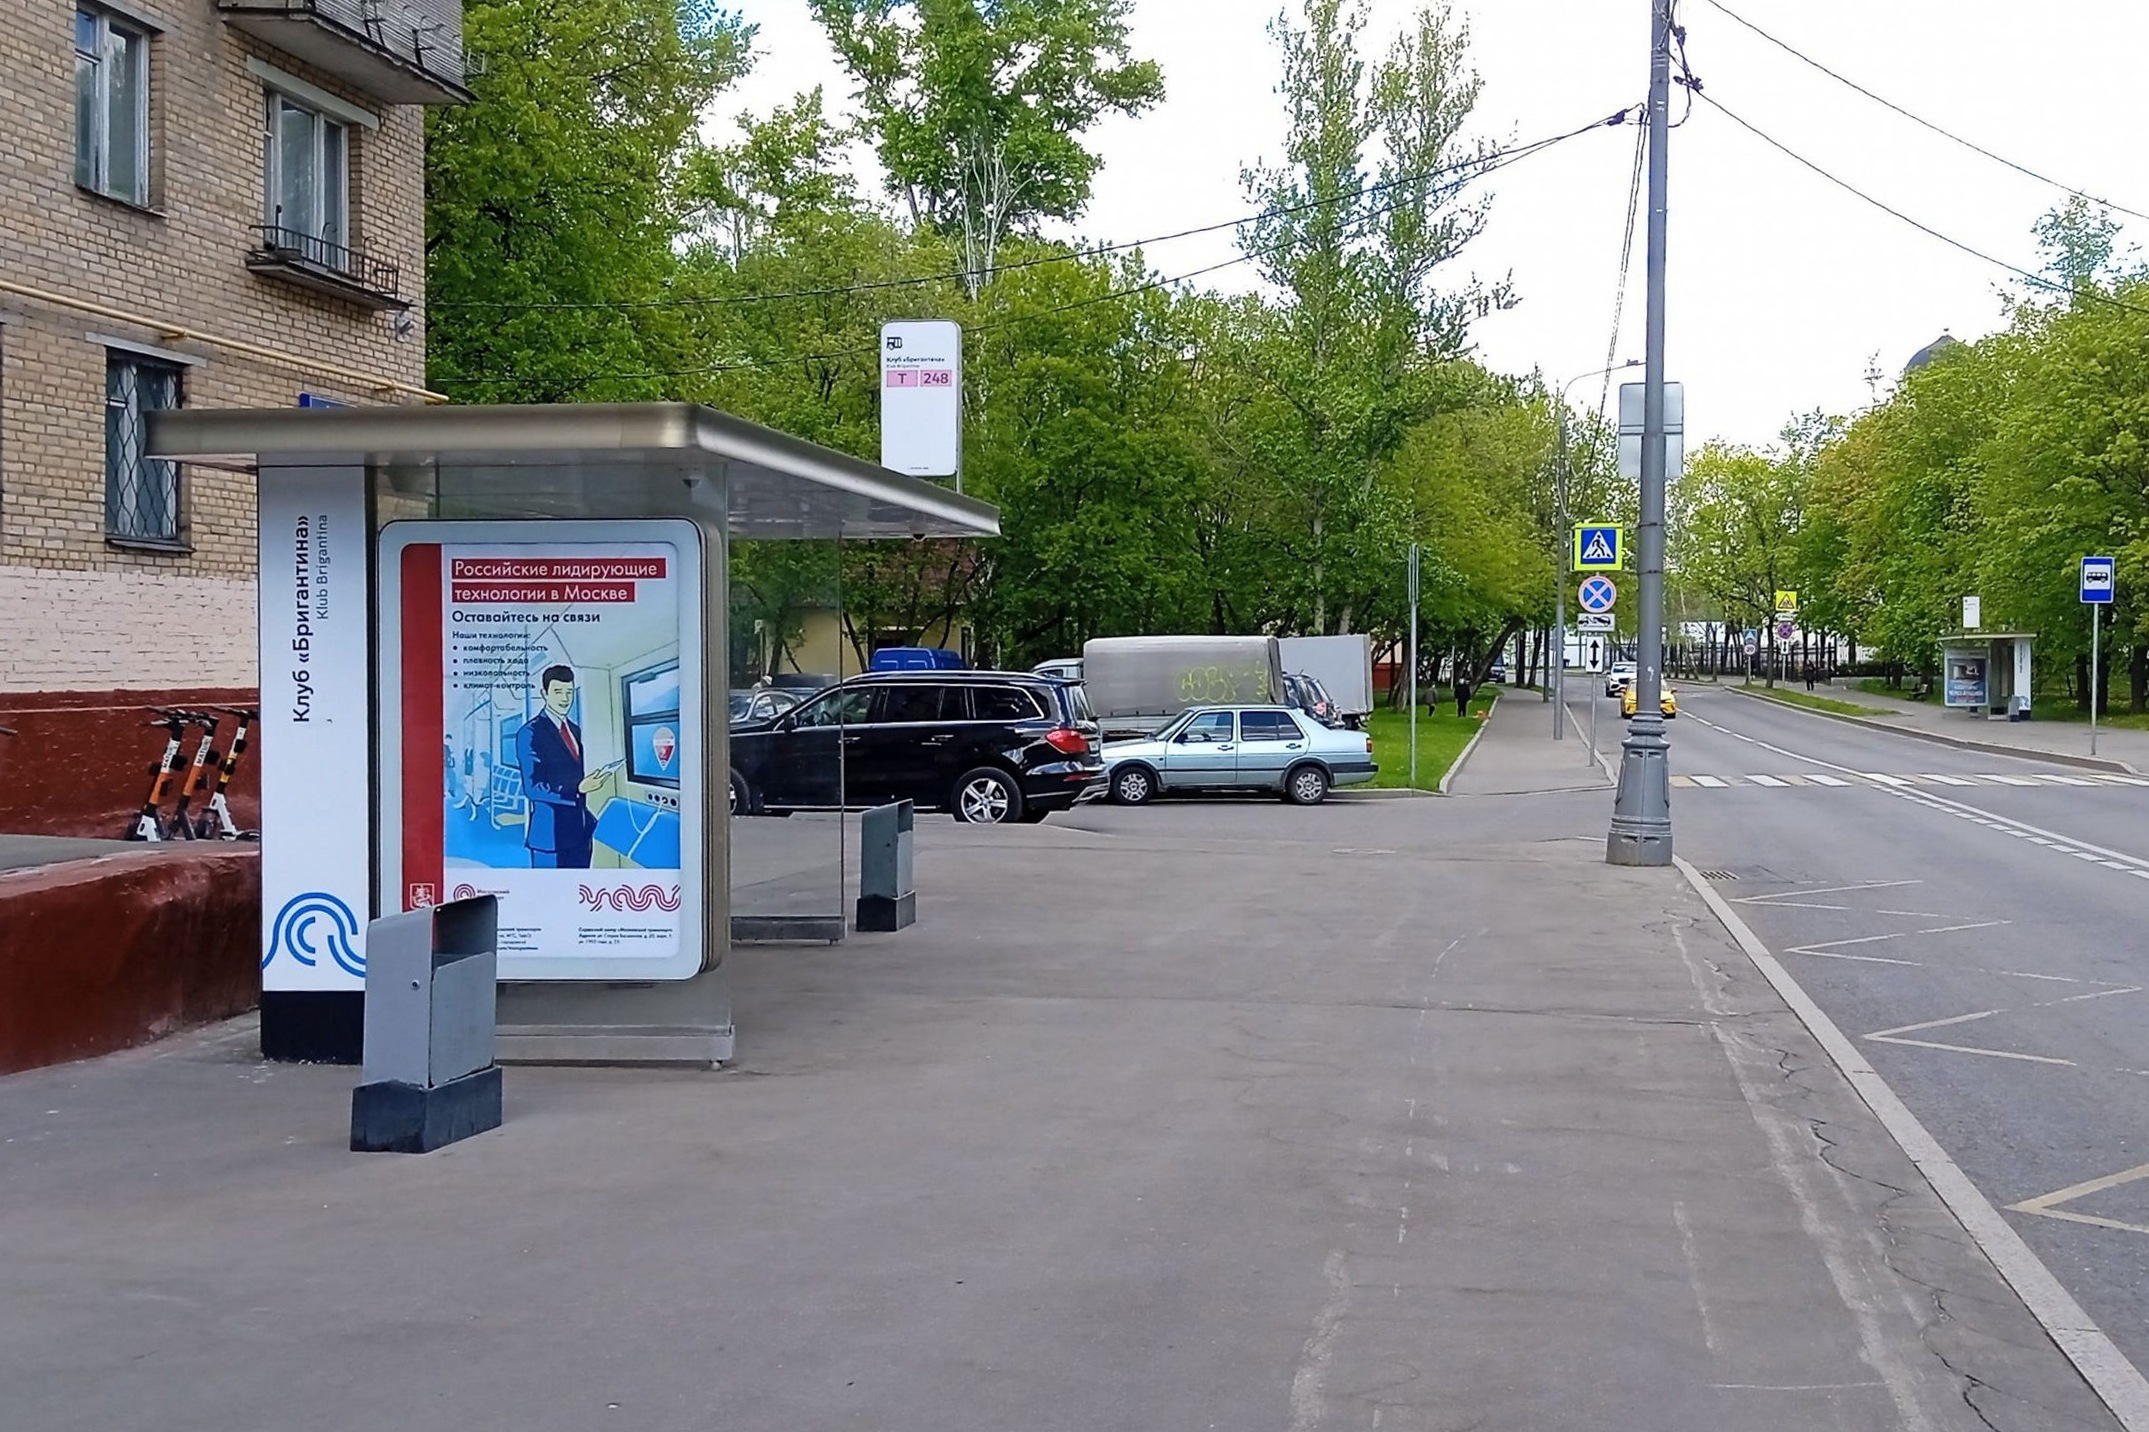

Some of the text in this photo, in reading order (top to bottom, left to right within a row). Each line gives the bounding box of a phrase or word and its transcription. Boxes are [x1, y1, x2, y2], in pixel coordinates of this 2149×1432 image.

[923, 372, 949, 384] 248
[316, 514, 331, 620] Klub Brigantina
[454, 560, 658, 579] Российские лидирующие
[454, 585, 628, 601] технологии в Москве
[292, 515, 314, 723] Клуб «Бригантина»
[452, 610, 601, 623] Оставайтесь на связи
[452, 631, 477, 639] Наши
[463, 643, 548, 653] комфортабельность
[507, 658, 529, 666] хода
